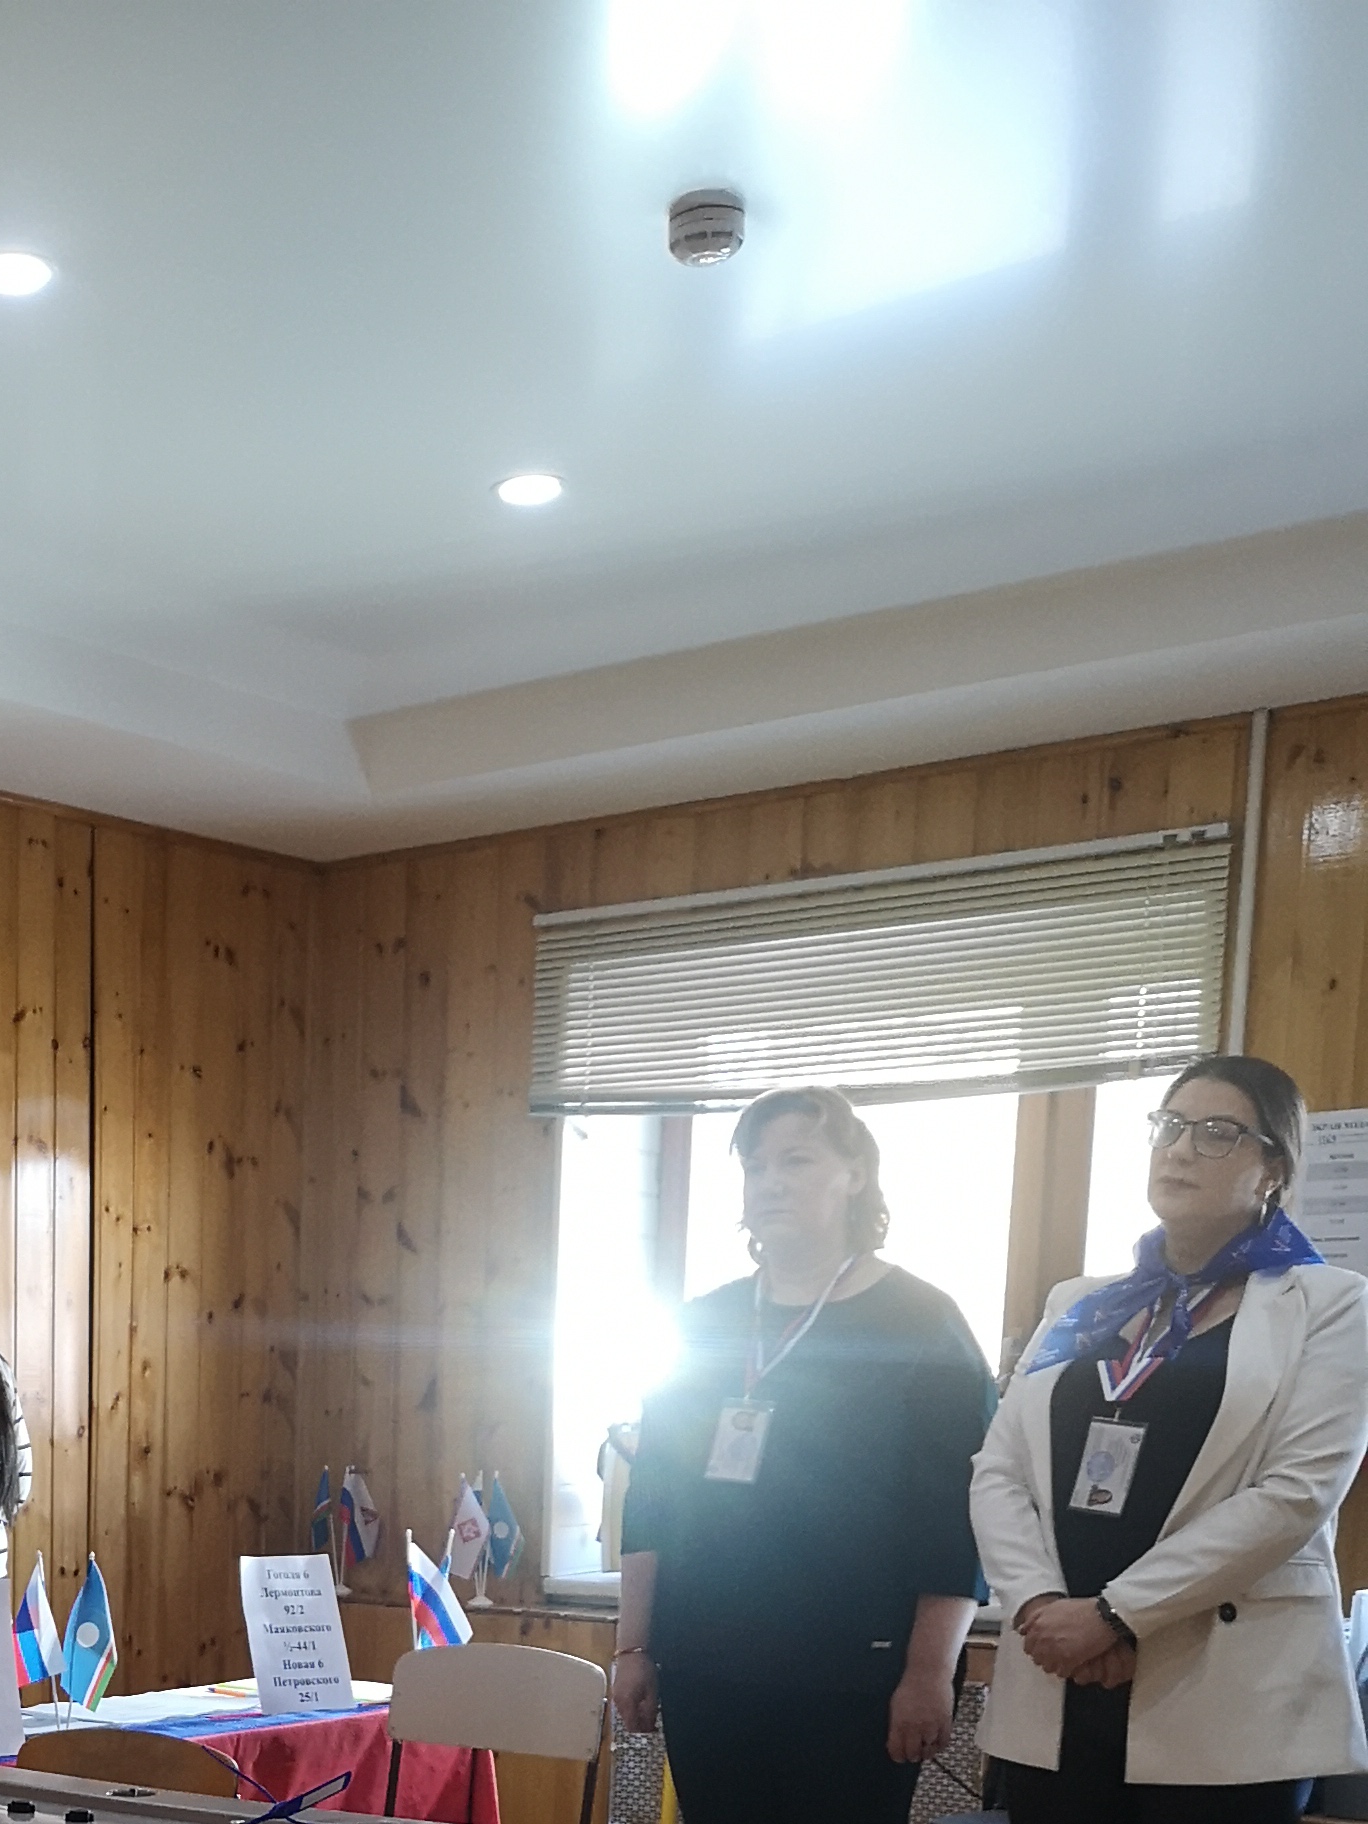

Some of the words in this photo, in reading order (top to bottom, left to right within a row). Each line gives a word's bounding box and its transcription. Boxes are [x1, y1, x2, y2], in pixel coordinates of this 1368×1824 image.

[260, 1587, 322, 1599] Лермонтова
[283, 1605, 305, 1615] 92/2
[283, 1660, 315, 1670] Новая
[318, 1659, 325, 1669] 6
[273, 1676, 340, 1689] Петровского
[298, 1692, 319, 1702] 25/1
